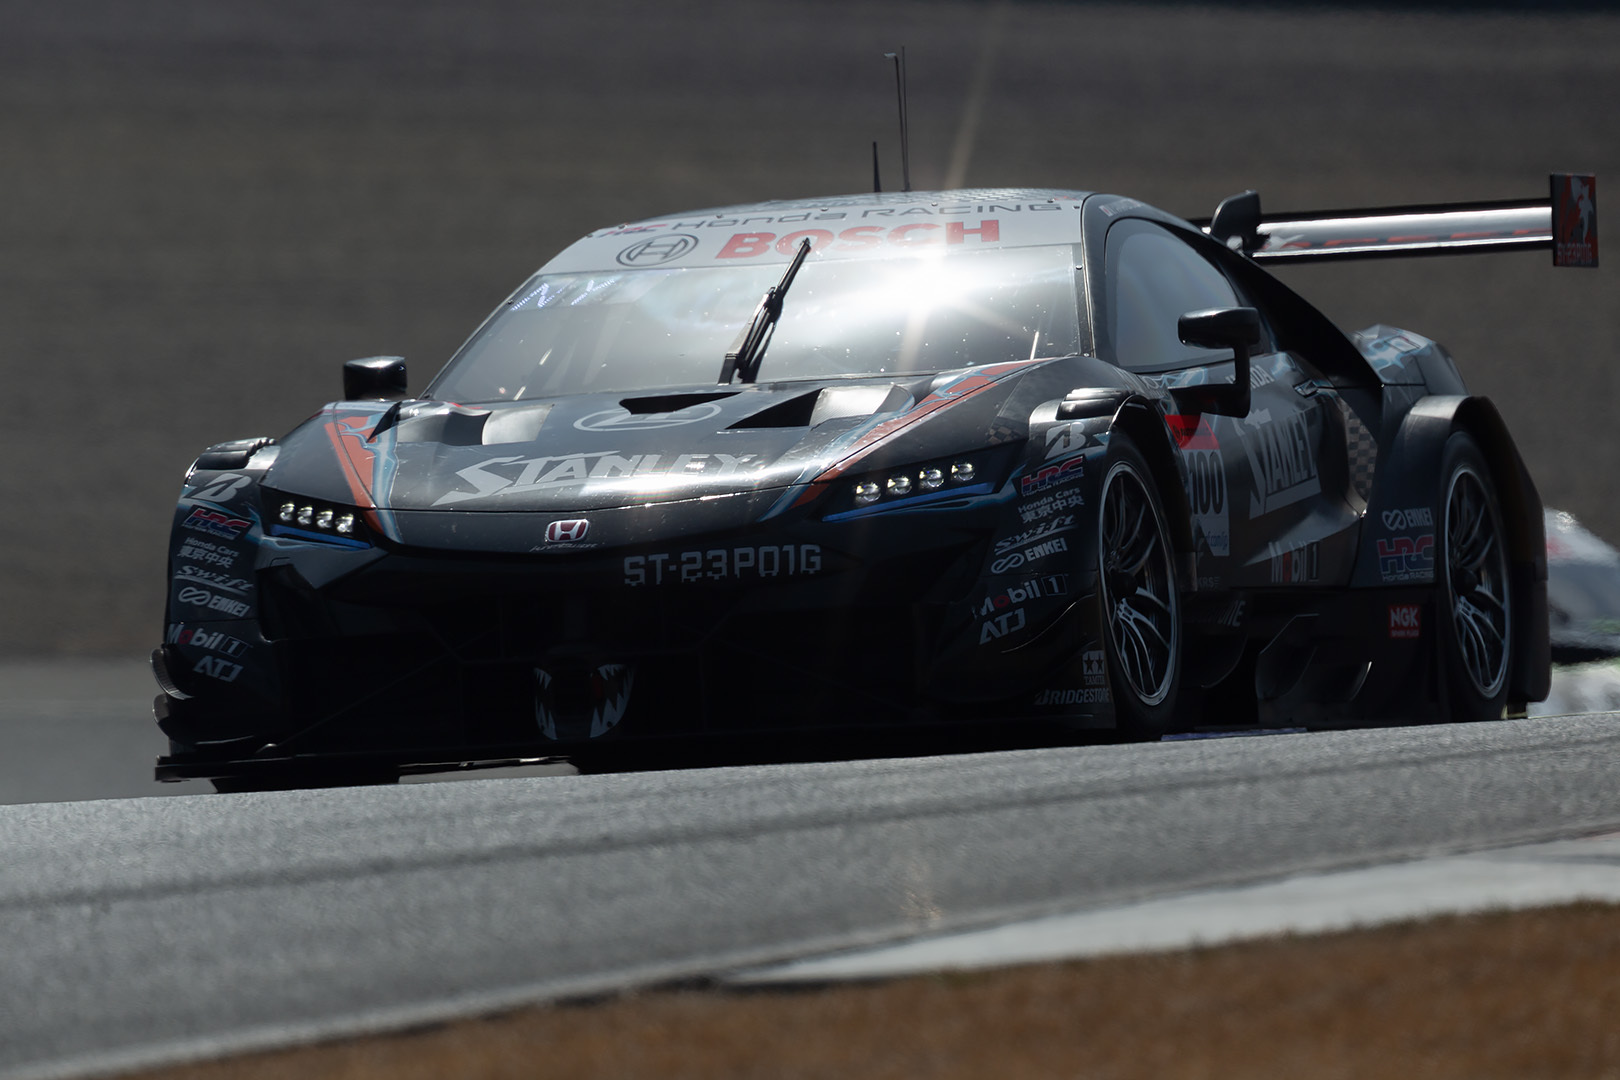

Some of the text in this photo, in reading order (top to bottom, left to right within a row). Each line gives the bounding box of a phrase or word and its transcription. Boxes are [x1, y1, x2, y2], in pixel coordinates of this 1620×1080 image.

[672, 207, 846, 231] Honda
[861, 203, 1062, 218] RACING
[715, 219, 1000, 259] BOSCH
[432, 449, 757, 506] STANLEY
[1018, 487, 1080, 514] Honda Cars
[184, 536, 217, 551] Honda
[1024, 537, 1068, 562] ENKEI
[623, 544, 822, 587] ST-23P01G
[207, 595, 251, 618] ENKEI
[972, 580, 1042, 620] Mobil
[1390, 607, 1419, 628] NGK
[166, 623, 225, 651] Mobil
